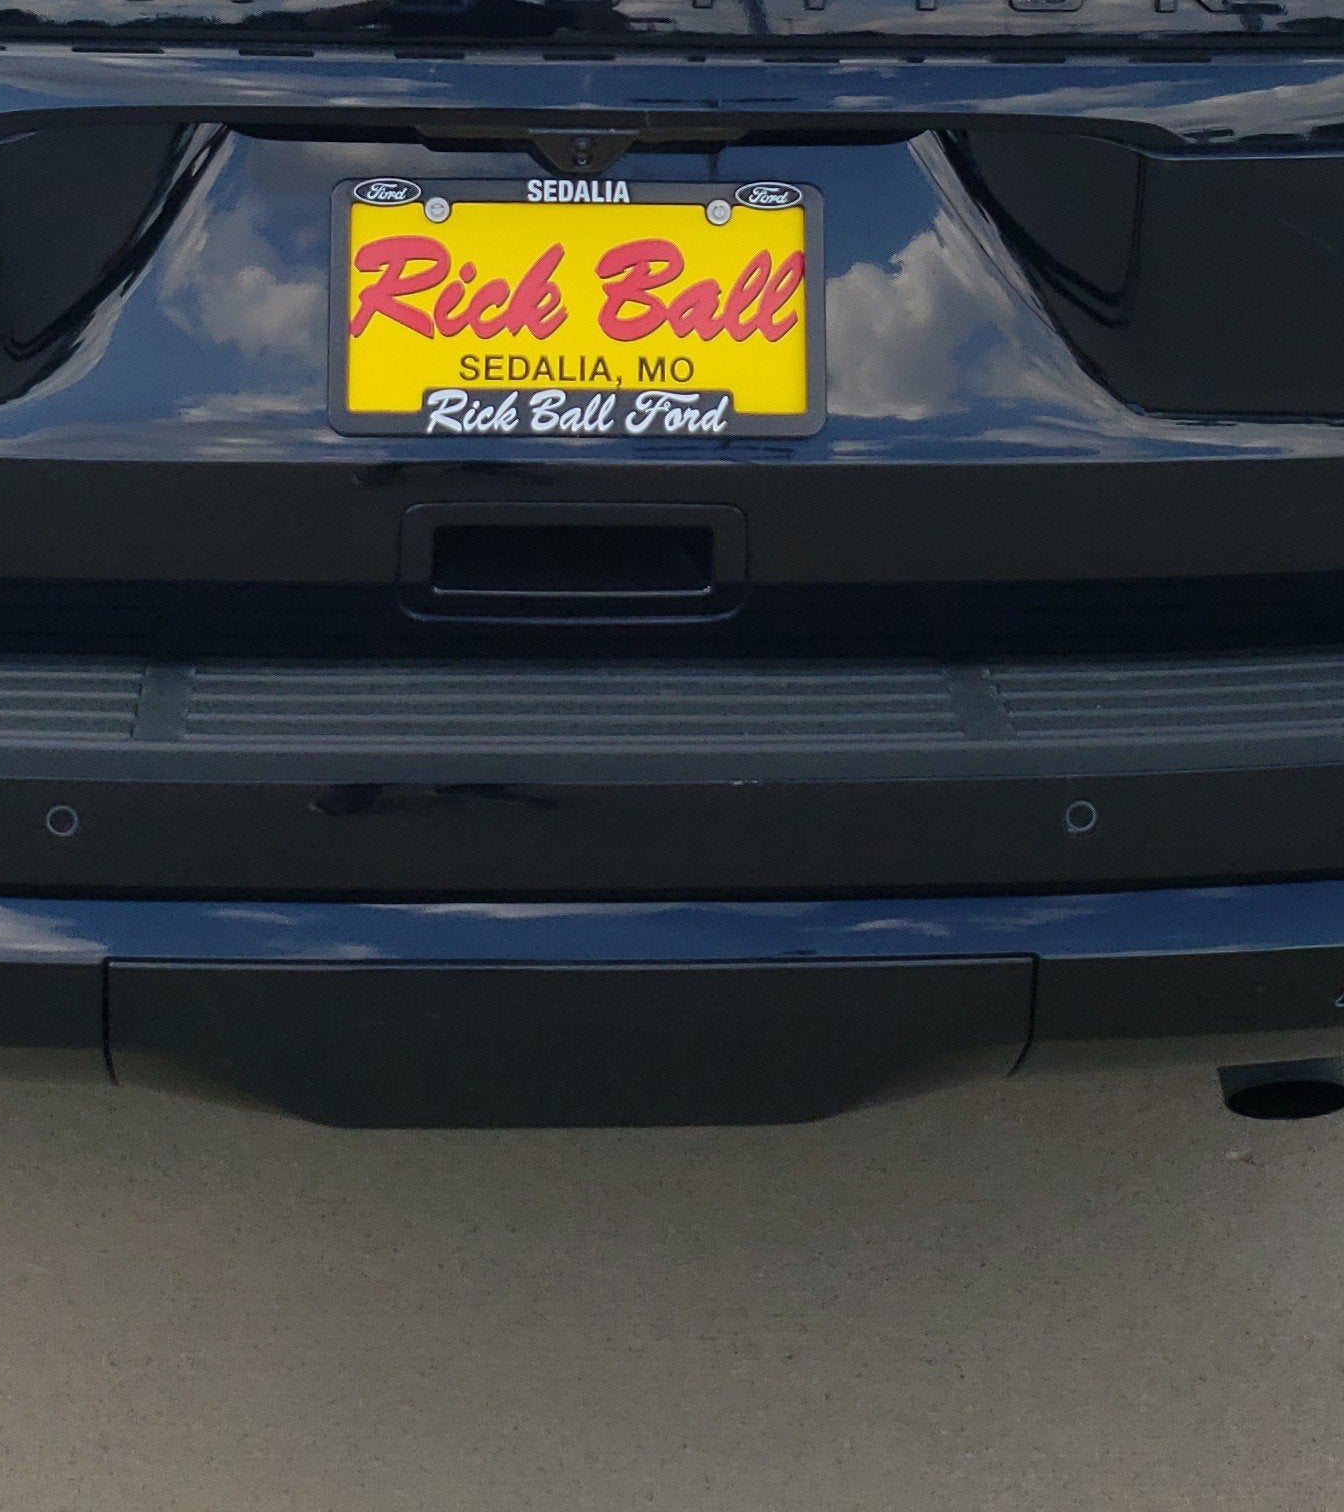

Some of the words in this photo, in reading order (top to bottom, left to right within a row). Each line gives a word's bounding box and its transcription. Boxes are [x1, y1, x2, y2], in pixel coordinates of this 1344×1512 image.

[366, 183, 408, 200] Ford
[527, 180, 630, 204] SEDALIA
[749, 186, 789, 203] Ford
[348, 235, 568, 339] Rick
[596, 238, 805, 342] Ball
[459, 355, 622, 387] SEDALIA,
[638, 356, 695, 383] MO
[426, 389, 519, 433] Rick
[528, 389, 616, 434] Ball
[625, 391, 729, 434] Ford
